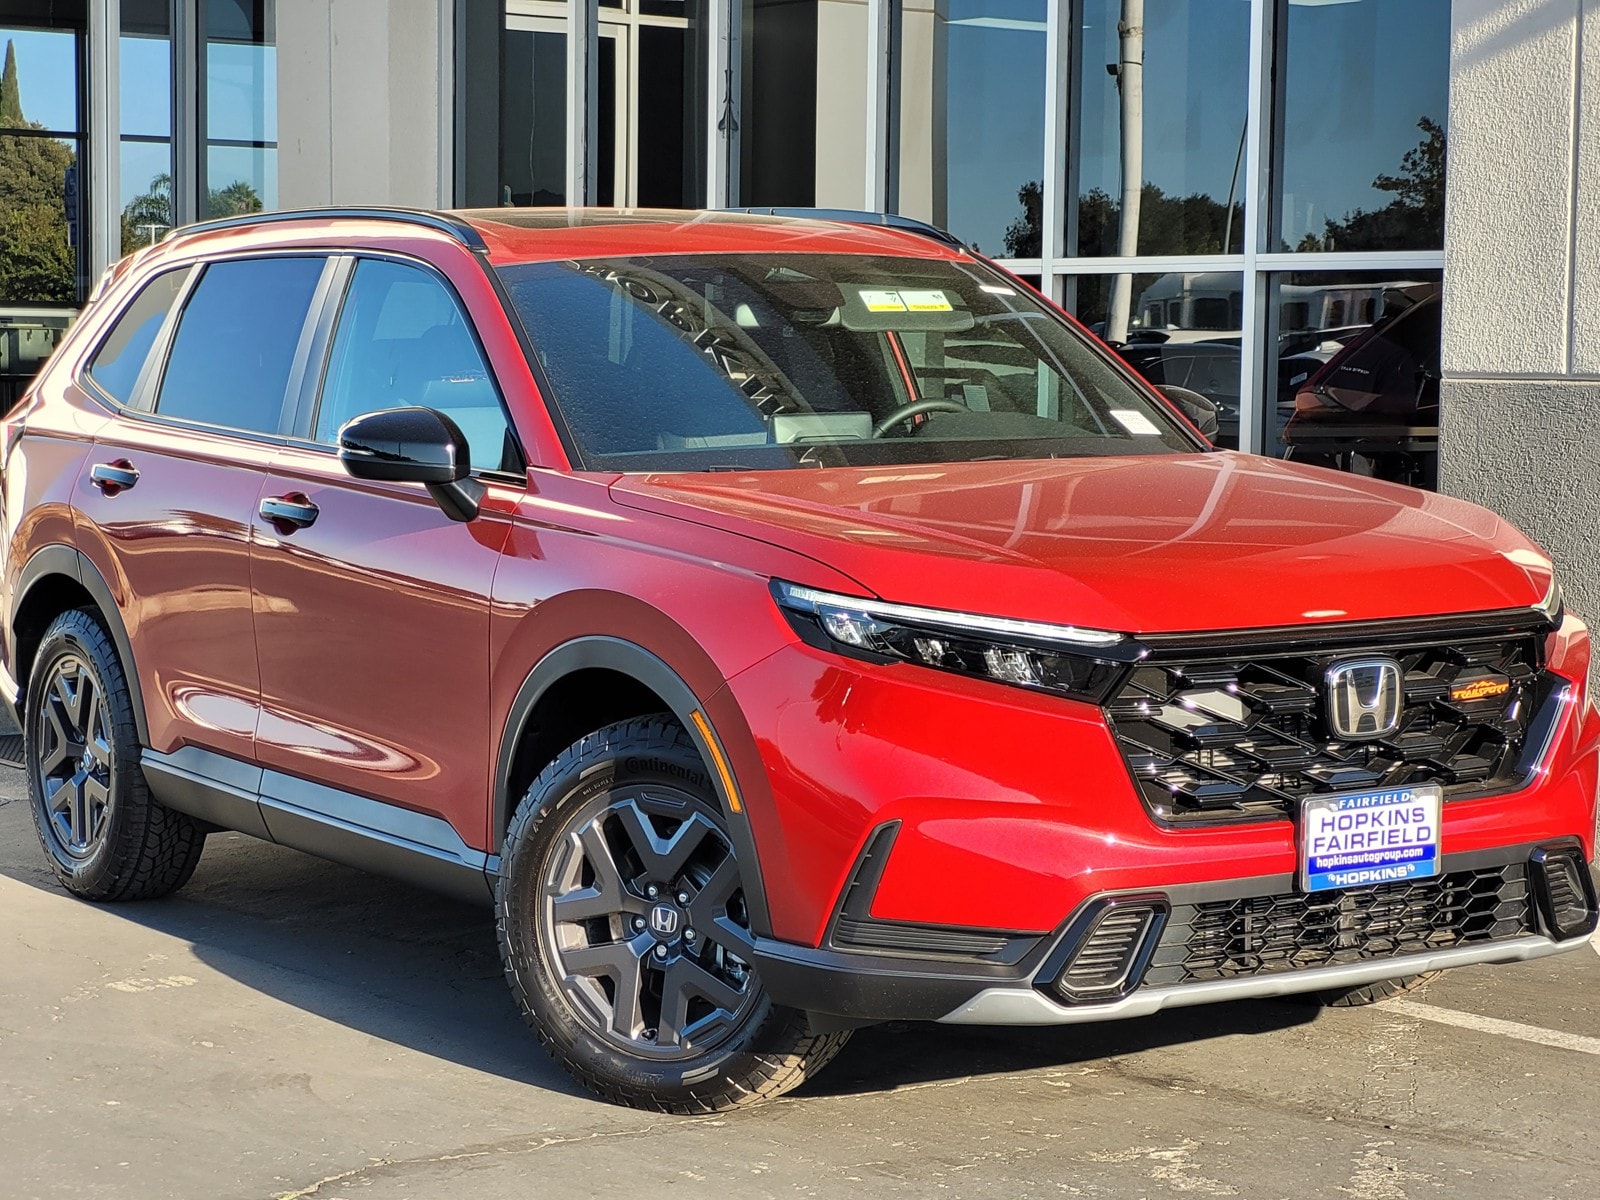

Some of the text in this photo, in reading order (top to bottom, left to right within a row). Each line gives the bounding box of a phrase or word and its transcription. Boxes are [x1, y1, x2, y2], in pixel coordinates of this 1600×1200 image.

[1452, 684, 1509, 699] TRAILSPORT
[624, 756, 705, 787] Continental
[1338, 793, 1410, 809] FAIRFIELD
[1321, 807, 1425, 833] HOPKINS
[1314, 826, 1431, 853] FAIRFIELD
[1316, 848, 1423, 868] hopkinsautogroup.com
[1336, 866, 1408, 885] HOPKINS
